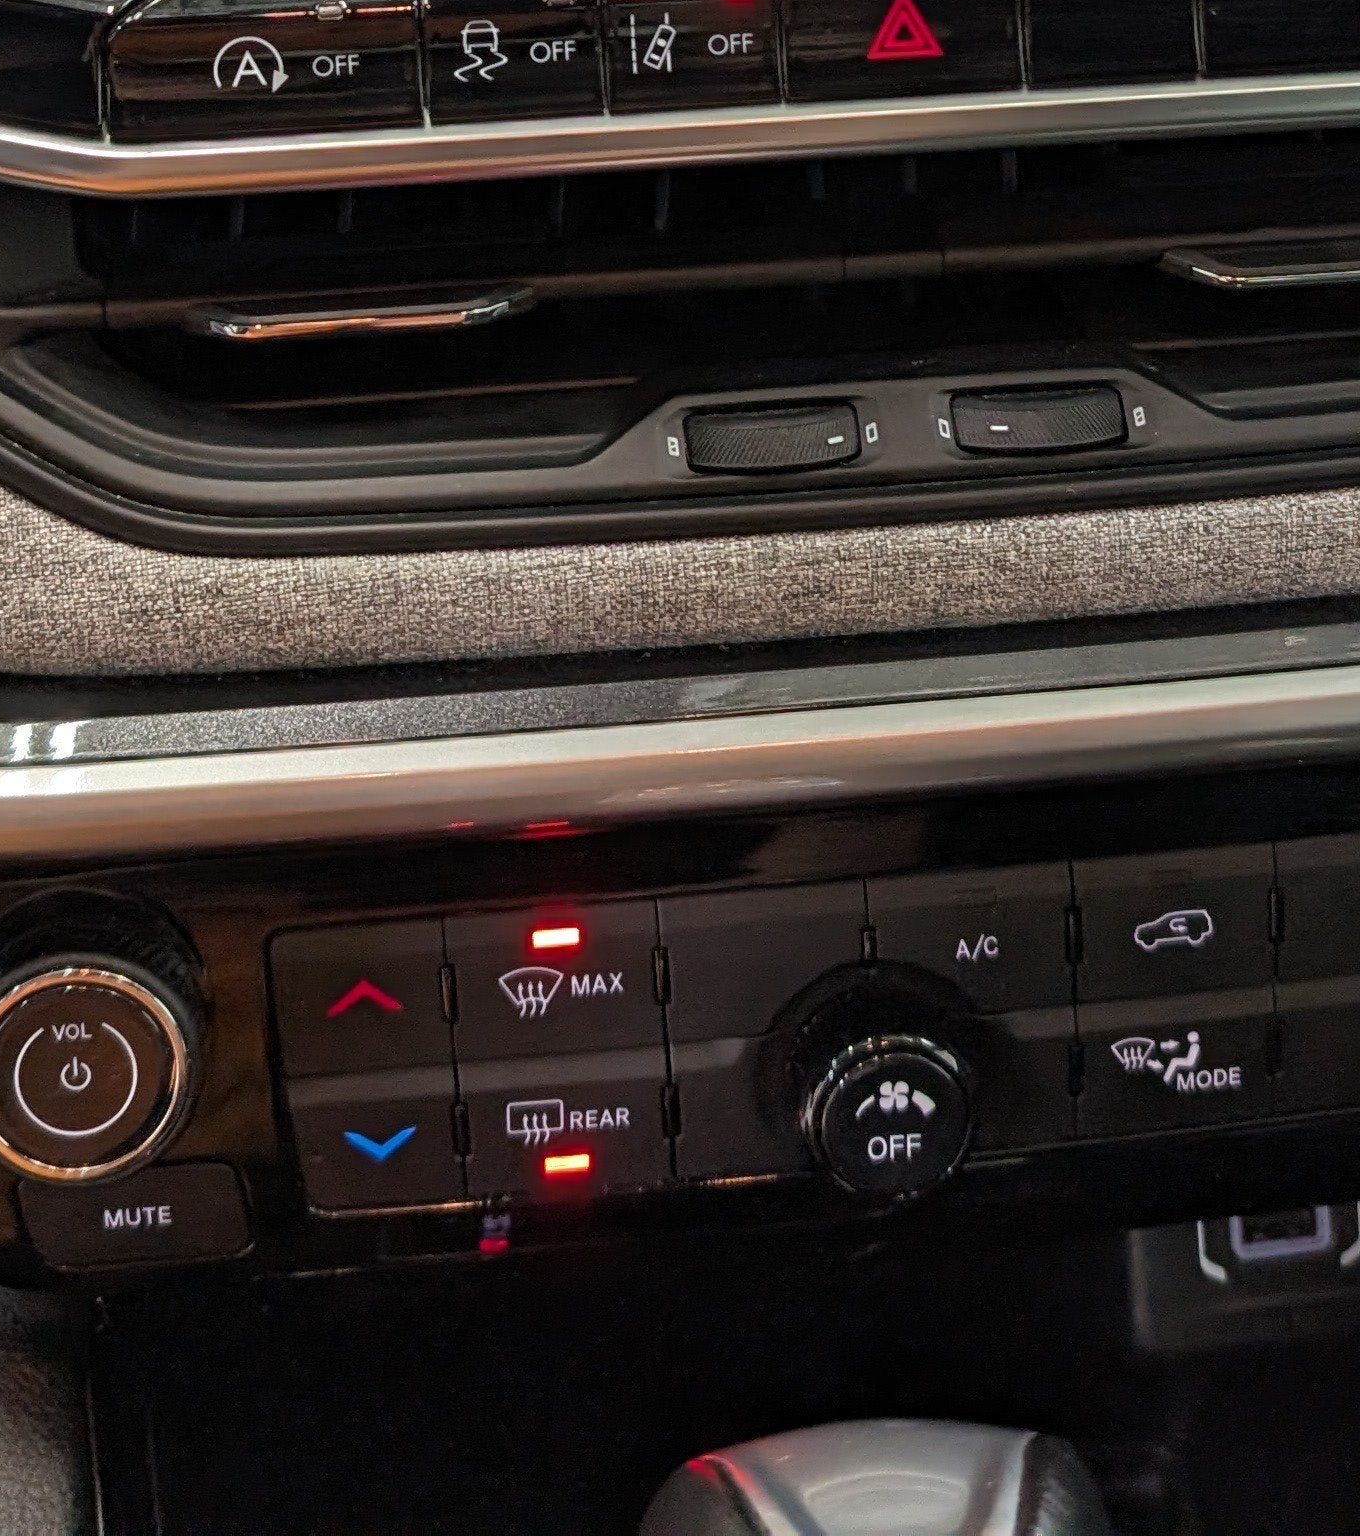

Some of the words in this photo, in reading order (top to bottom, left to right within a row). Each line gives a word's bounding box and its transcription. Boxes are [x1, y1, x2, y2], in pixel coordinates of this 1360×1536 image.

[529, 39, 577, 64] OFF
[707, 32, 754, 56] OFF
[311, 53, 360, 78] OFF
[955, 933, 999, 961] A/C
[570, 971, 624, 996] MAX
[51, 1022, 93, 1041] VOL
[1176, 1064, 1242, 1092] MODE
[569, 1107, 630, 1130] REAR
[867, 1133, 922, 1161] OFF
[103, 1205, 172, 1229] MUTE
